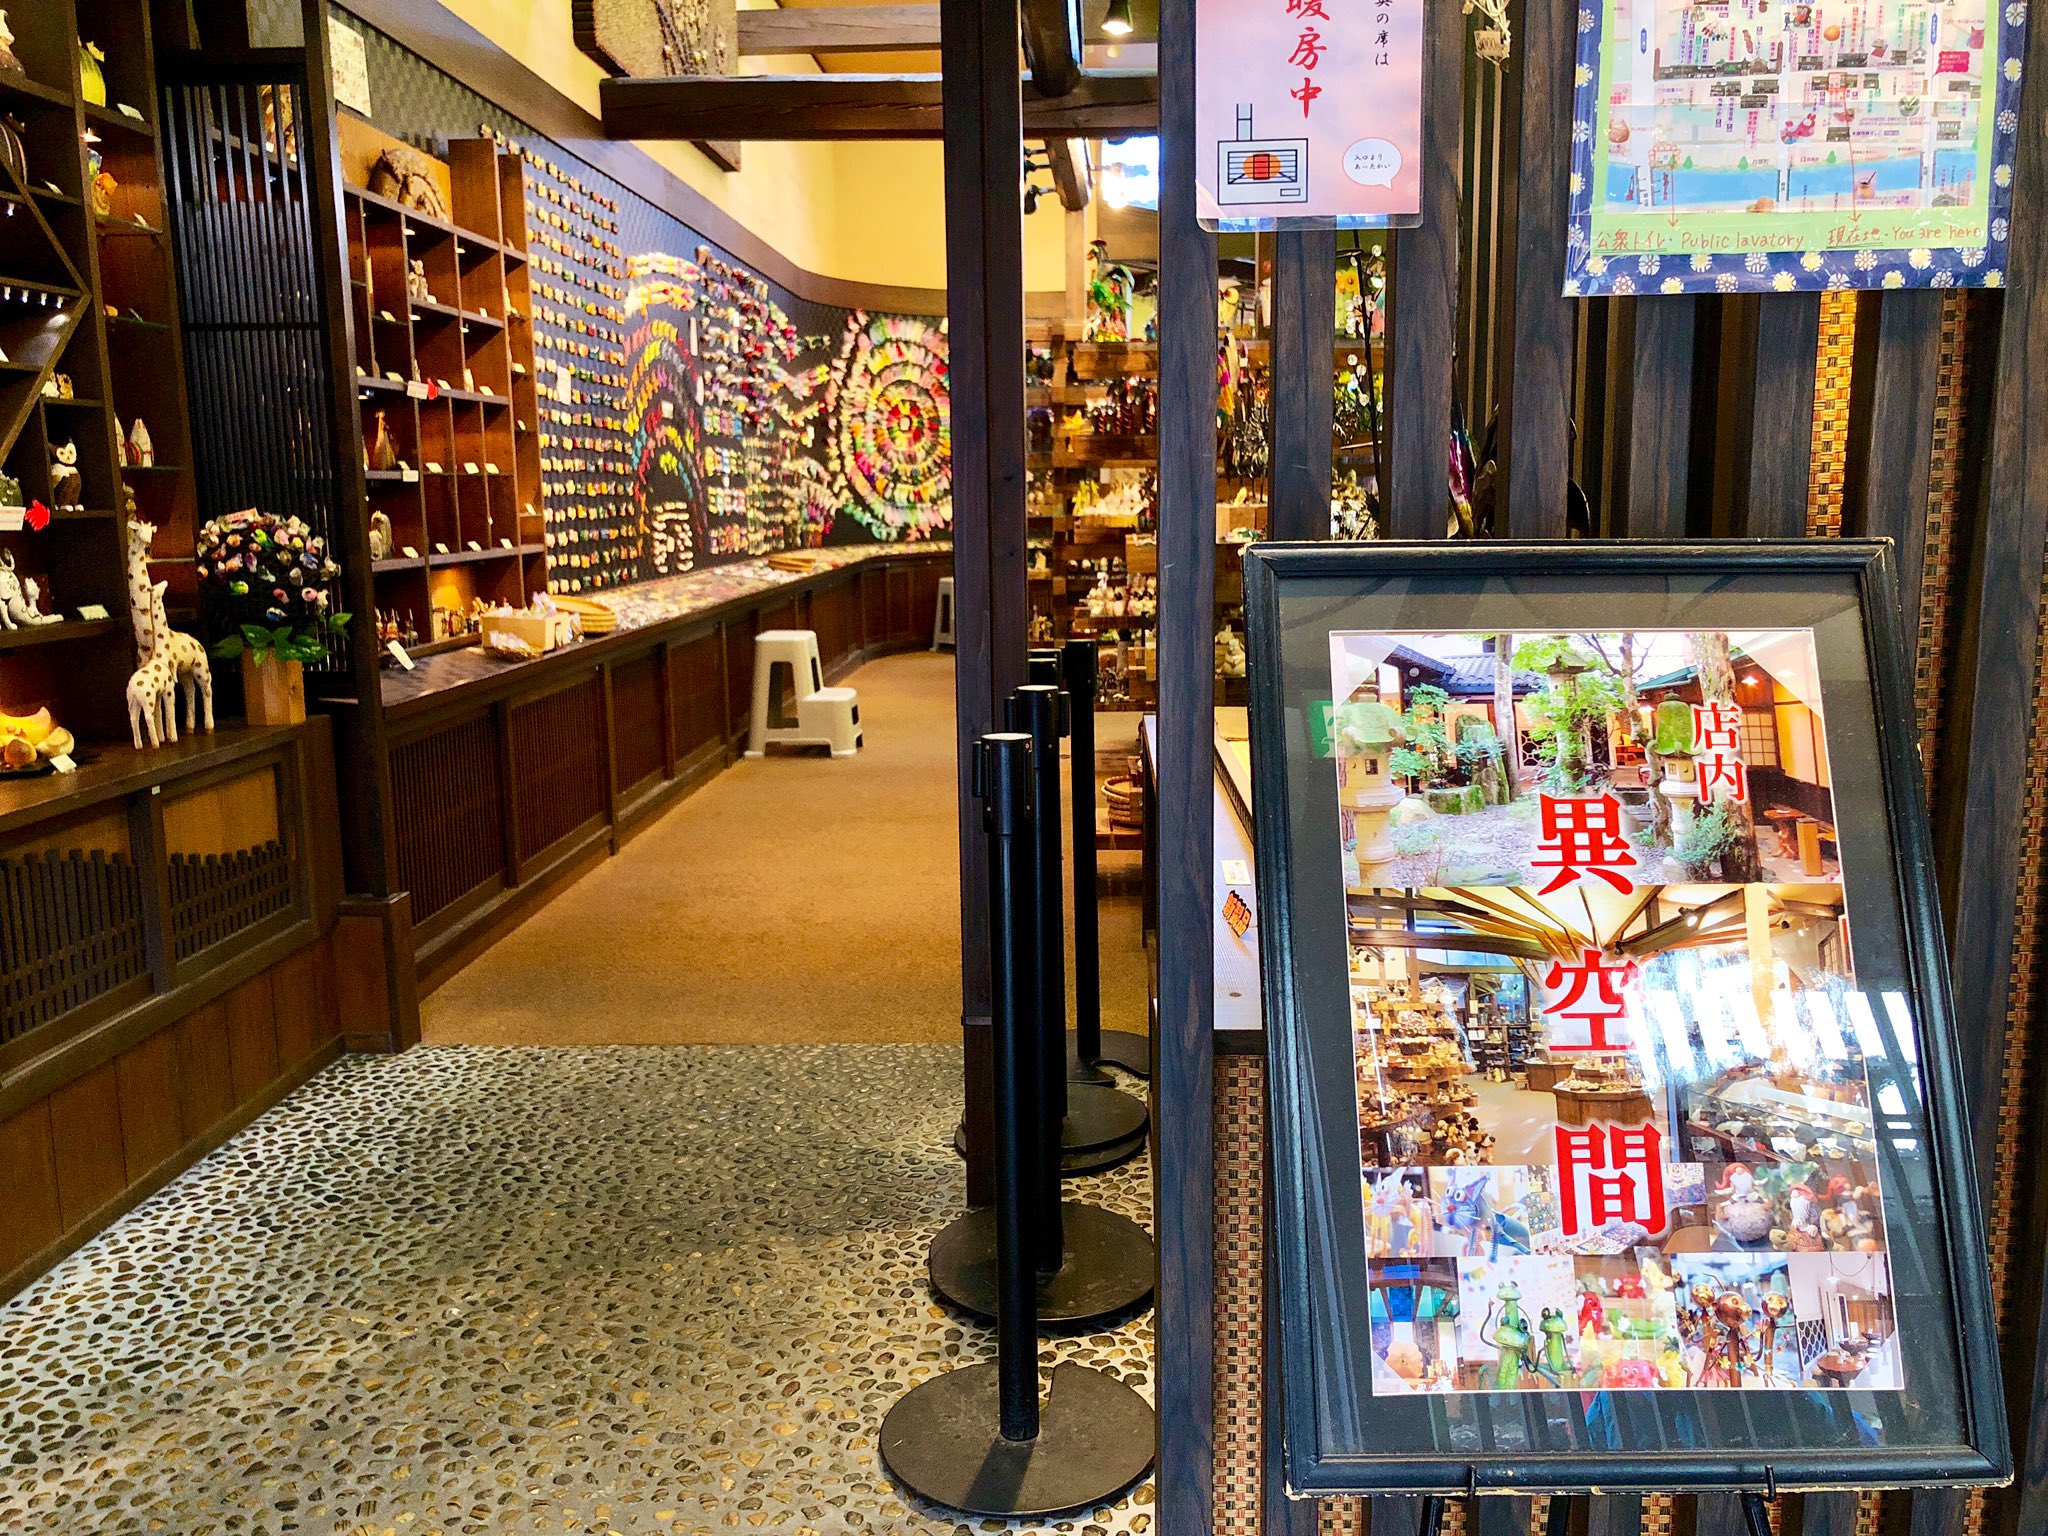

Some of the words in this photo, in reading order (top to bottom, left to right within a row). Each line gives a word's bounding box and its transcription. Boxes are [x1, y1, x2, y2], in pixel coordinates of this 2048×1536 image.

[1354, 153, 1383, 161] 入口より
[1681, 232, 1730, 249] Public
[1736, 232, 1805, 250] lavatory
[1891, 226, 1914, 241] You
[1919, 228, 1942, 239] are
[1949, 225, 1981, 239] here
[1693, 702, 1745, 802] 店内
[1531, 792, 1666, 1236] 異空間
